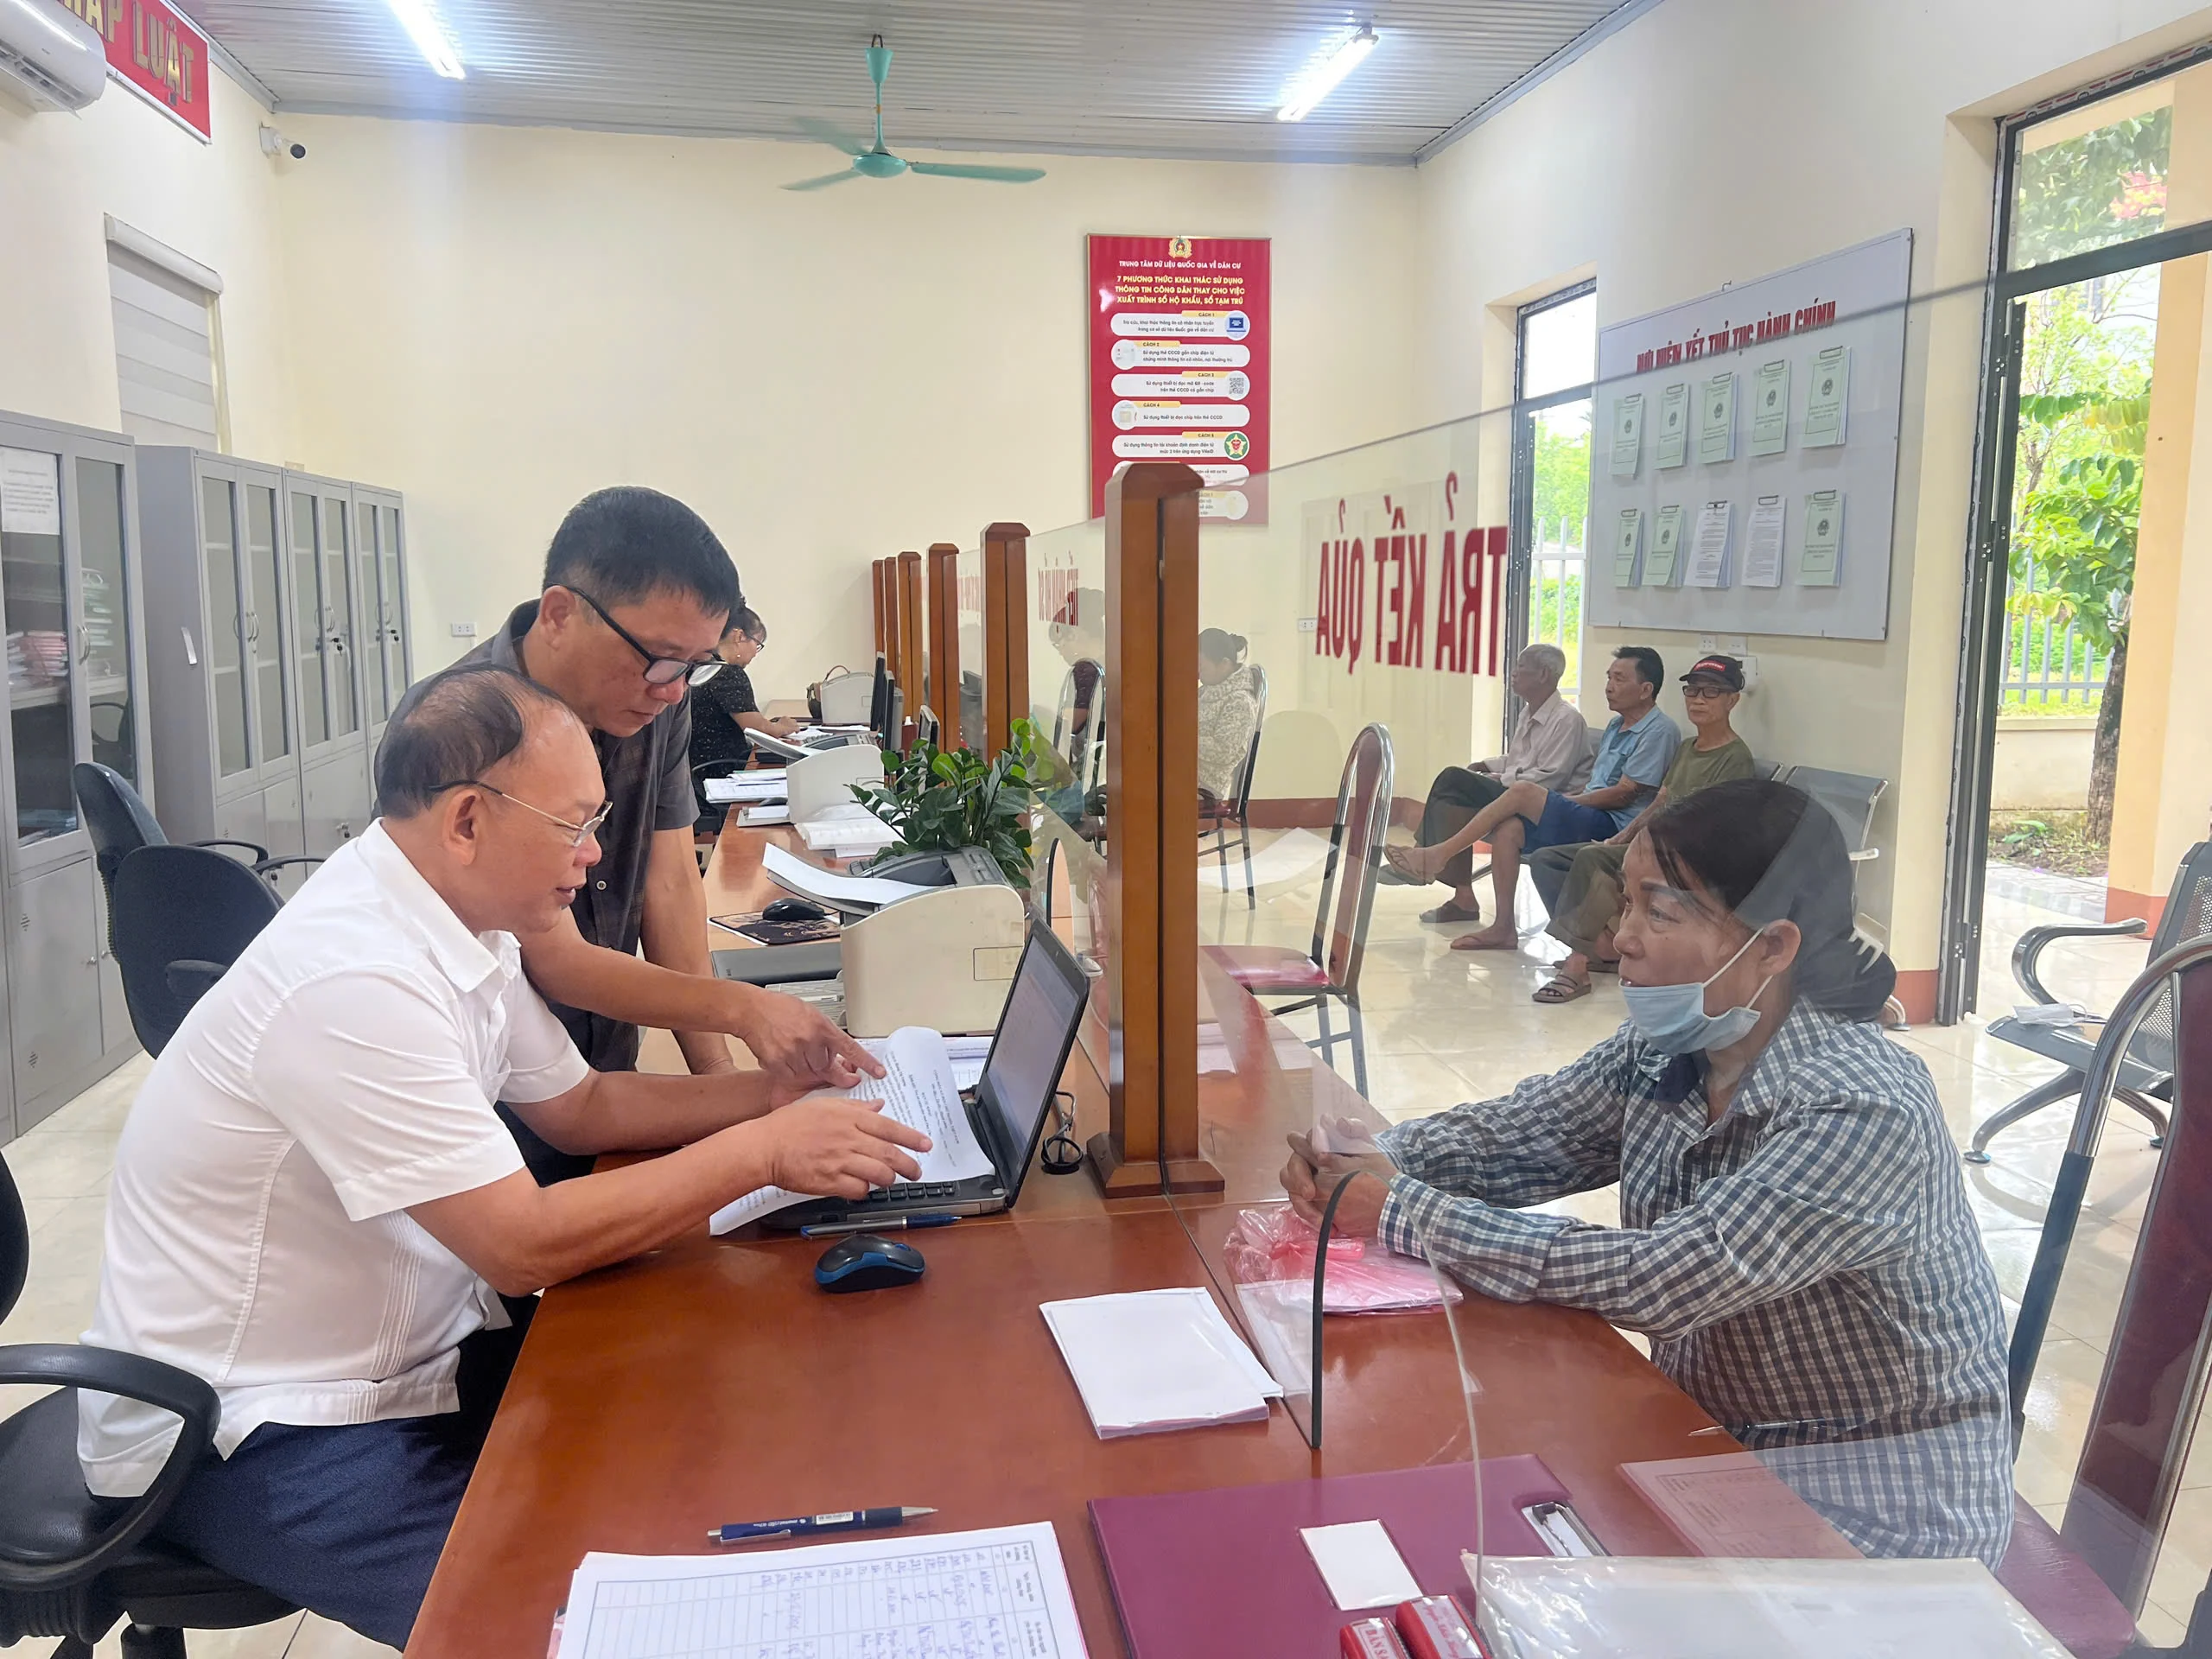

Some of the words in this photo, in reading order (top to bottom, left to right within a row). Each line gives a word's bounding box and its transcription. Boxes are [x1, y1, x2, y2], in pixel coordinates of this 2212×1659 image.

[133, 0, 194, 106] LUẬT
[1116, 284, 1140, 293] THÔNG
[1154, 285, 1175, 294] CÔNG
[1176, 285, 1192, 294] DÂN
[1230, 286, 1245, 296] VIỆC
[1154, 275, 1173, 283] THỨC
[1213, 275, 1222, 284] SỬ
[1224, 277, 1243, 286] DỤNG
[1686, 328, 1705, 361] YẾT
[1709, 321, 1730, 356] THỦ
[1732, 324, 1754, 356] TỤC
[1756, 311, 1791, 345] HÀNH
[1795, 297, 1836, 335] CHÍNH
